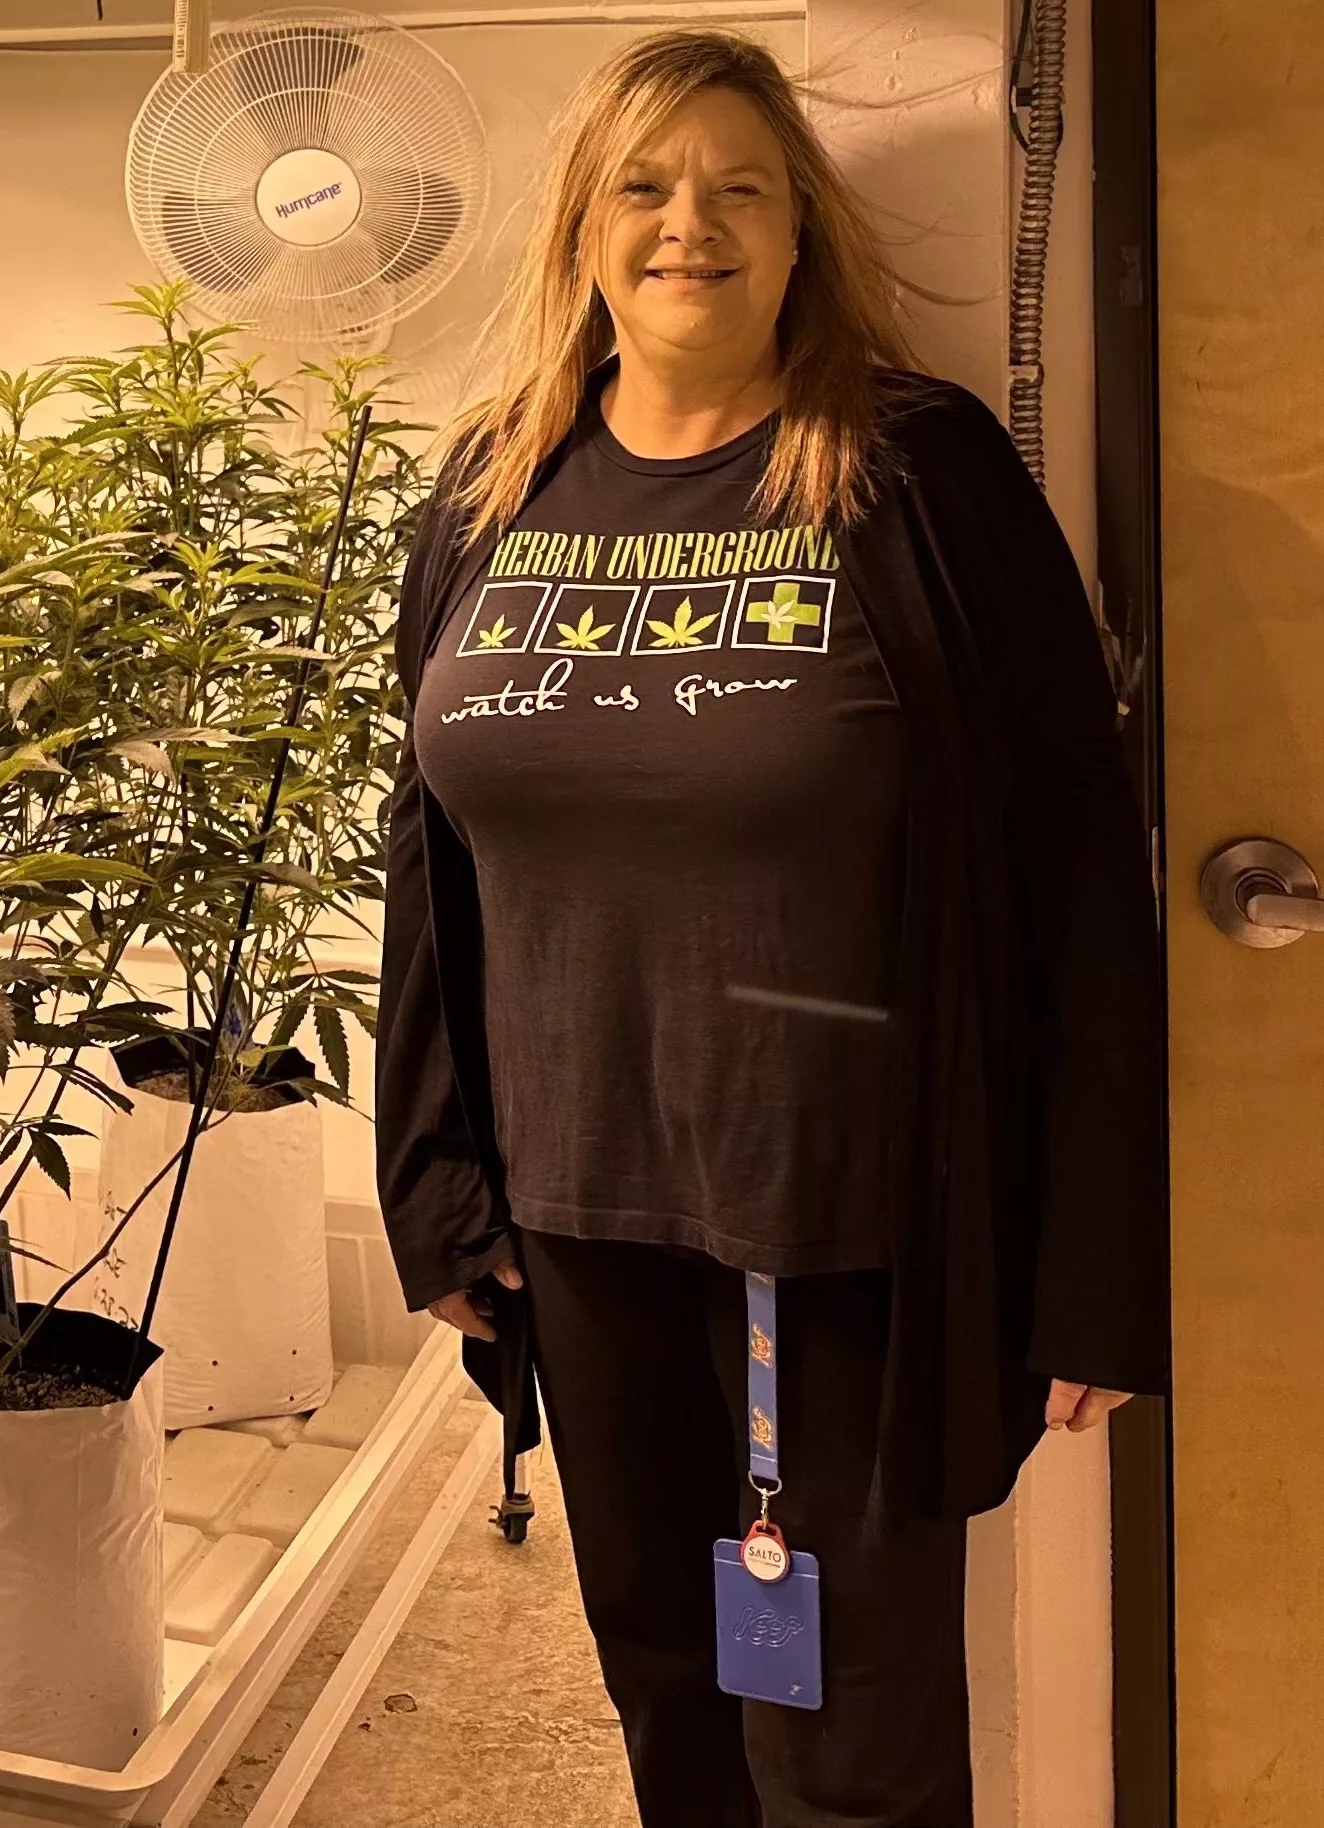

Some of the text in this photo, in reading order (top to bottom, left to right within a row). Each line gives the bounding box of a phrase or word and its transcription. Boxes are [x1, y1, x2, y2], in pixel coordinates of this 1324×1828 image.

[275, 182, 342, 218] Hurricane
[488, 525, 840, 580] HERBAN UNDERGROUND
[441, 657, 574, 725] watch
[593, 683, 640, 712] us
[748, 1546, 782, 1563] SALTO
